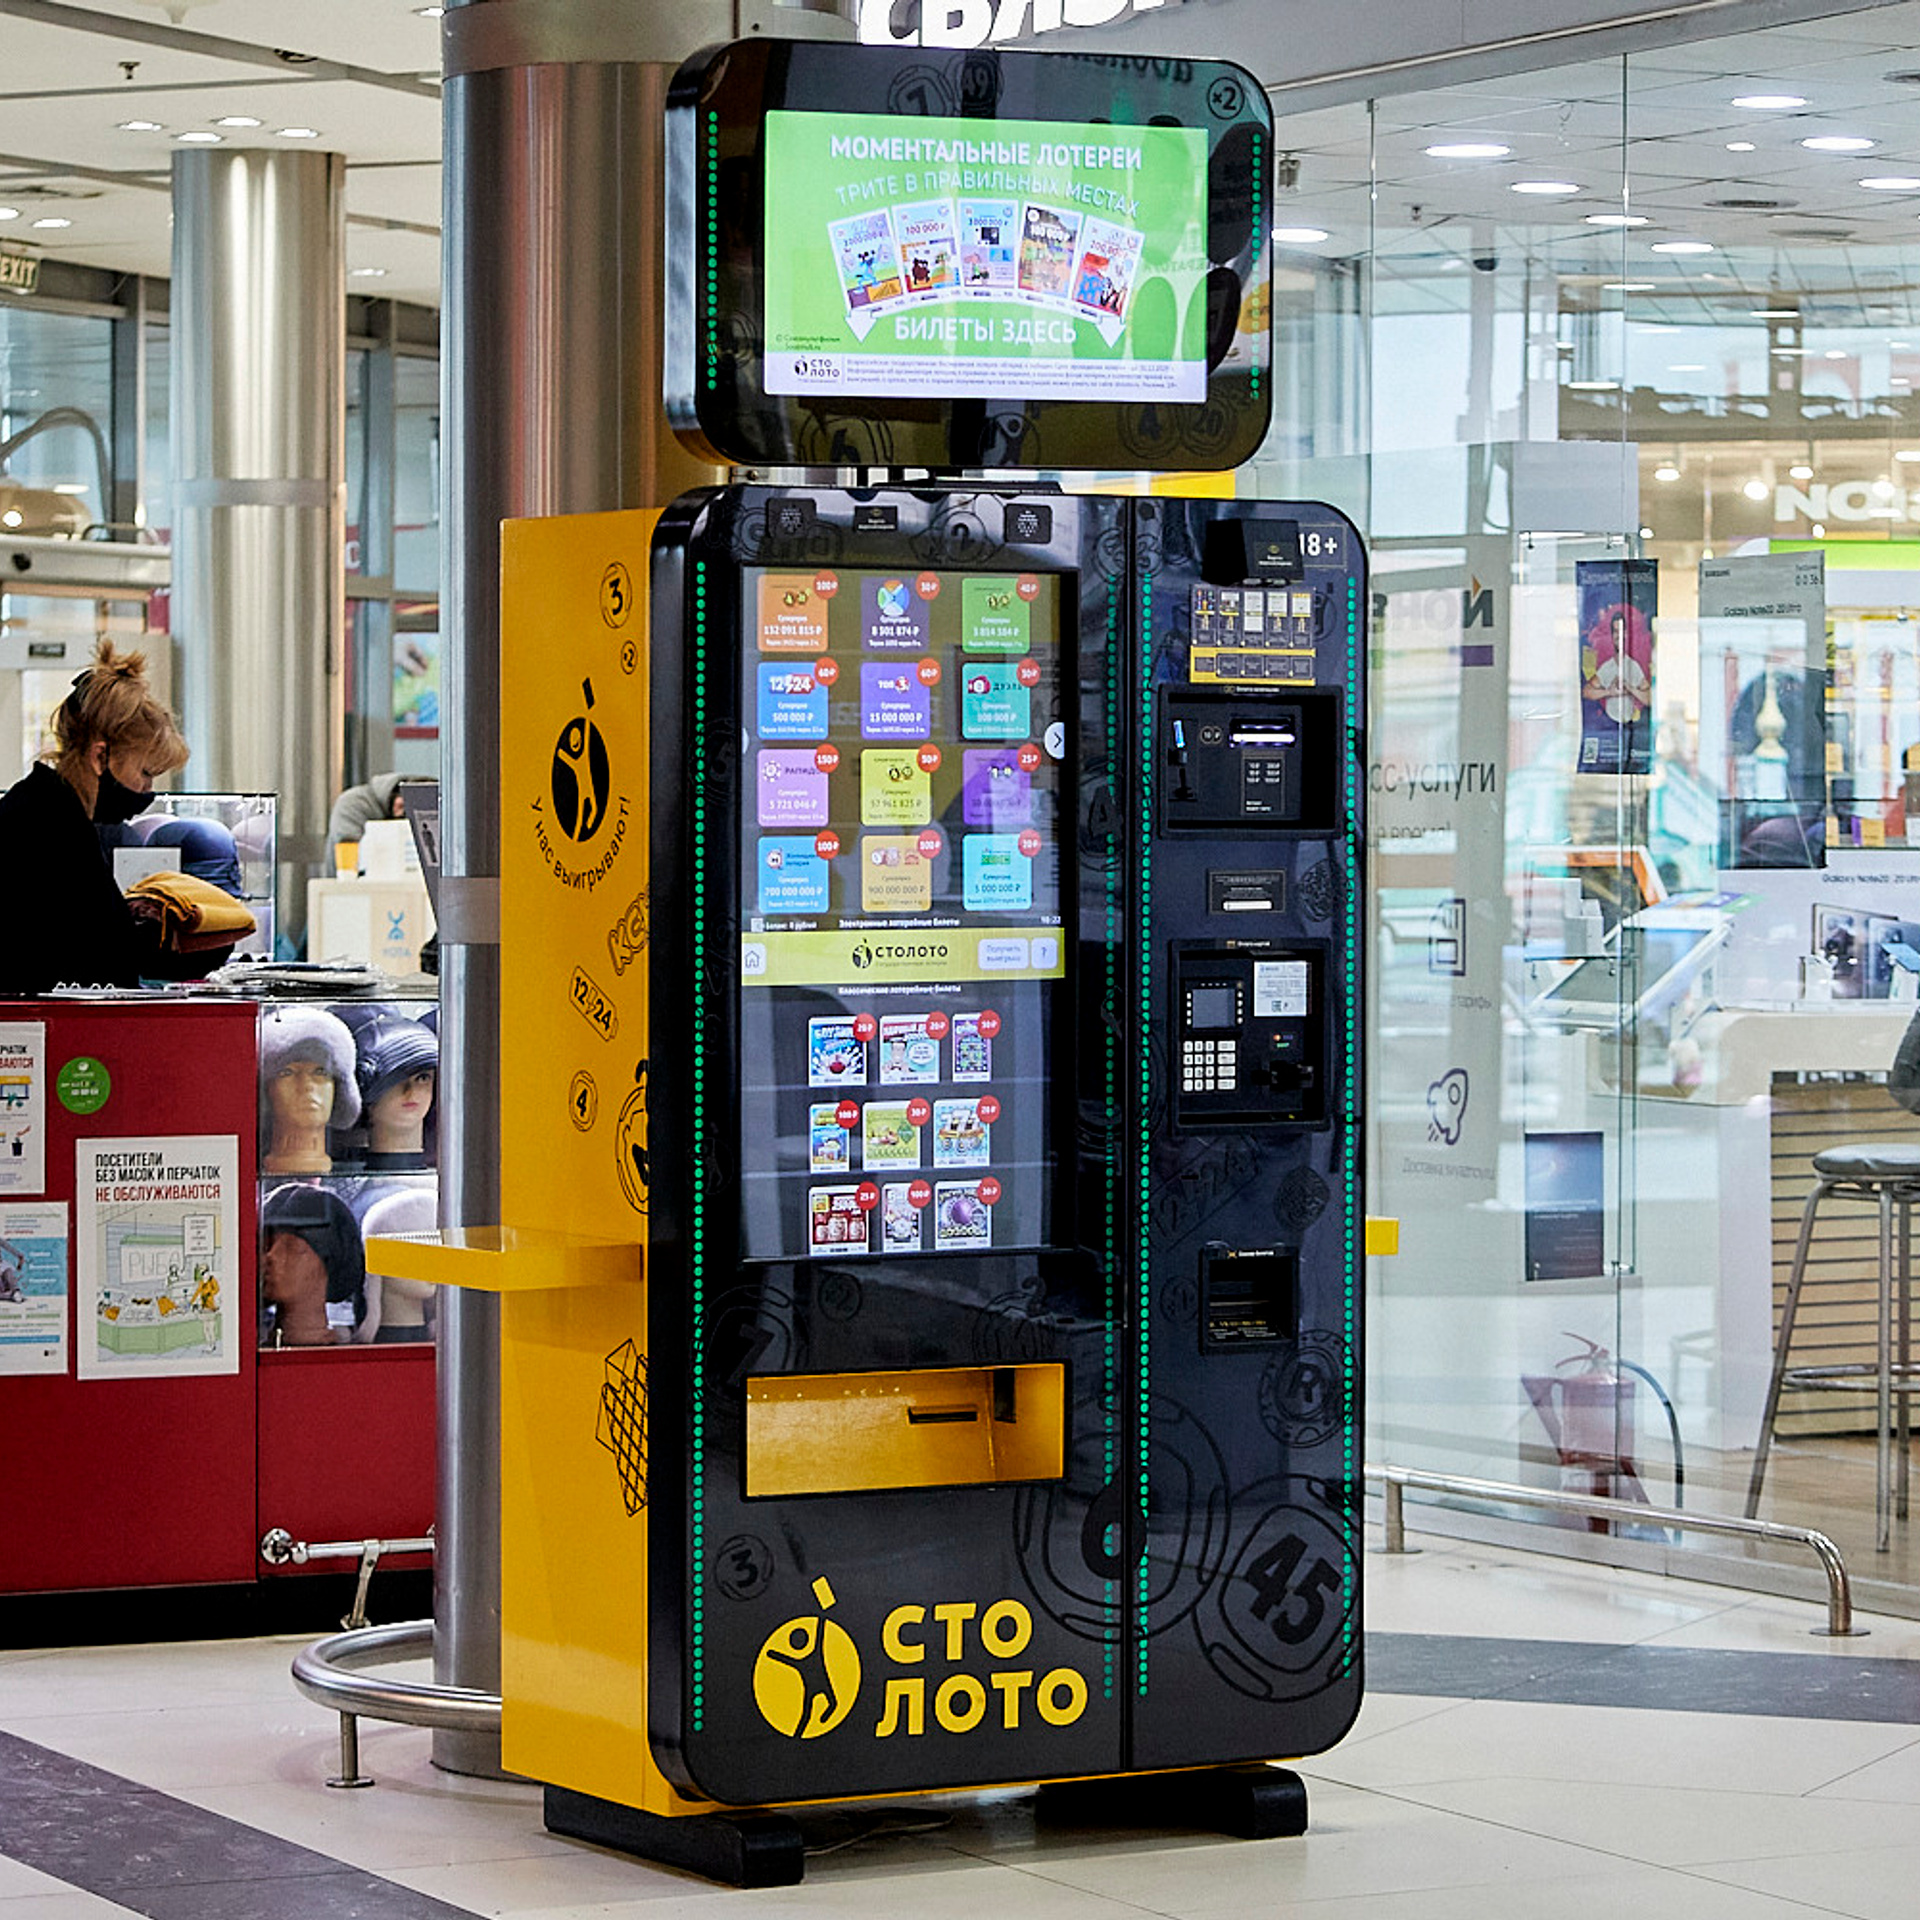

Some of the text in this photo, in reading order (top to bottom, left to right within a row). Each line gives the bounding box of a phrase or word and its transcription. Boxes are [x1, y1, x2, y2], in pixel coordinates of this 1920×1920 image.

[830, 134, 1142, 170] МОМЕНТАЛЬНЫЕ ЛОТЕРЕИ
[836, 169, 1140, 218] ТРИТЕ В ПРАВИЛЬНЫХ МЕСТАХ
[0, 256, 36, 286] EXIT
[895, 316, 1076, 345] БИЛЕТЫ ЗДЕСЬ
[810, 359, 832, 368] СТО
[810, 369, 840, 378] ЛОТО
[1300, 533, 1338, 556] 18+
[608, 576, 623, 616] 3
[531, 796, 631, 893] У нас выигрывают!
[875, 946, 948, 958] СТОЛОТО
[575, 1088, 588, 1117] 4
[96, 1153, 163, 1167] ПОСЕТИТЕЛИ
[96, 1166, 220, 1182] БЕЗ МАСОК И ПЕРЧАТОК
[96, 1184, 220, 1202] НЕ ОБСЛУЖИВАЮТСЯ
[731, 1551, 760, 1589] 3
[1243, 1533, 1342, 1647] 45
[882, 1599, 1033, 1664] СТО
[876, 1668, 1088, 1738] ЛОТО
